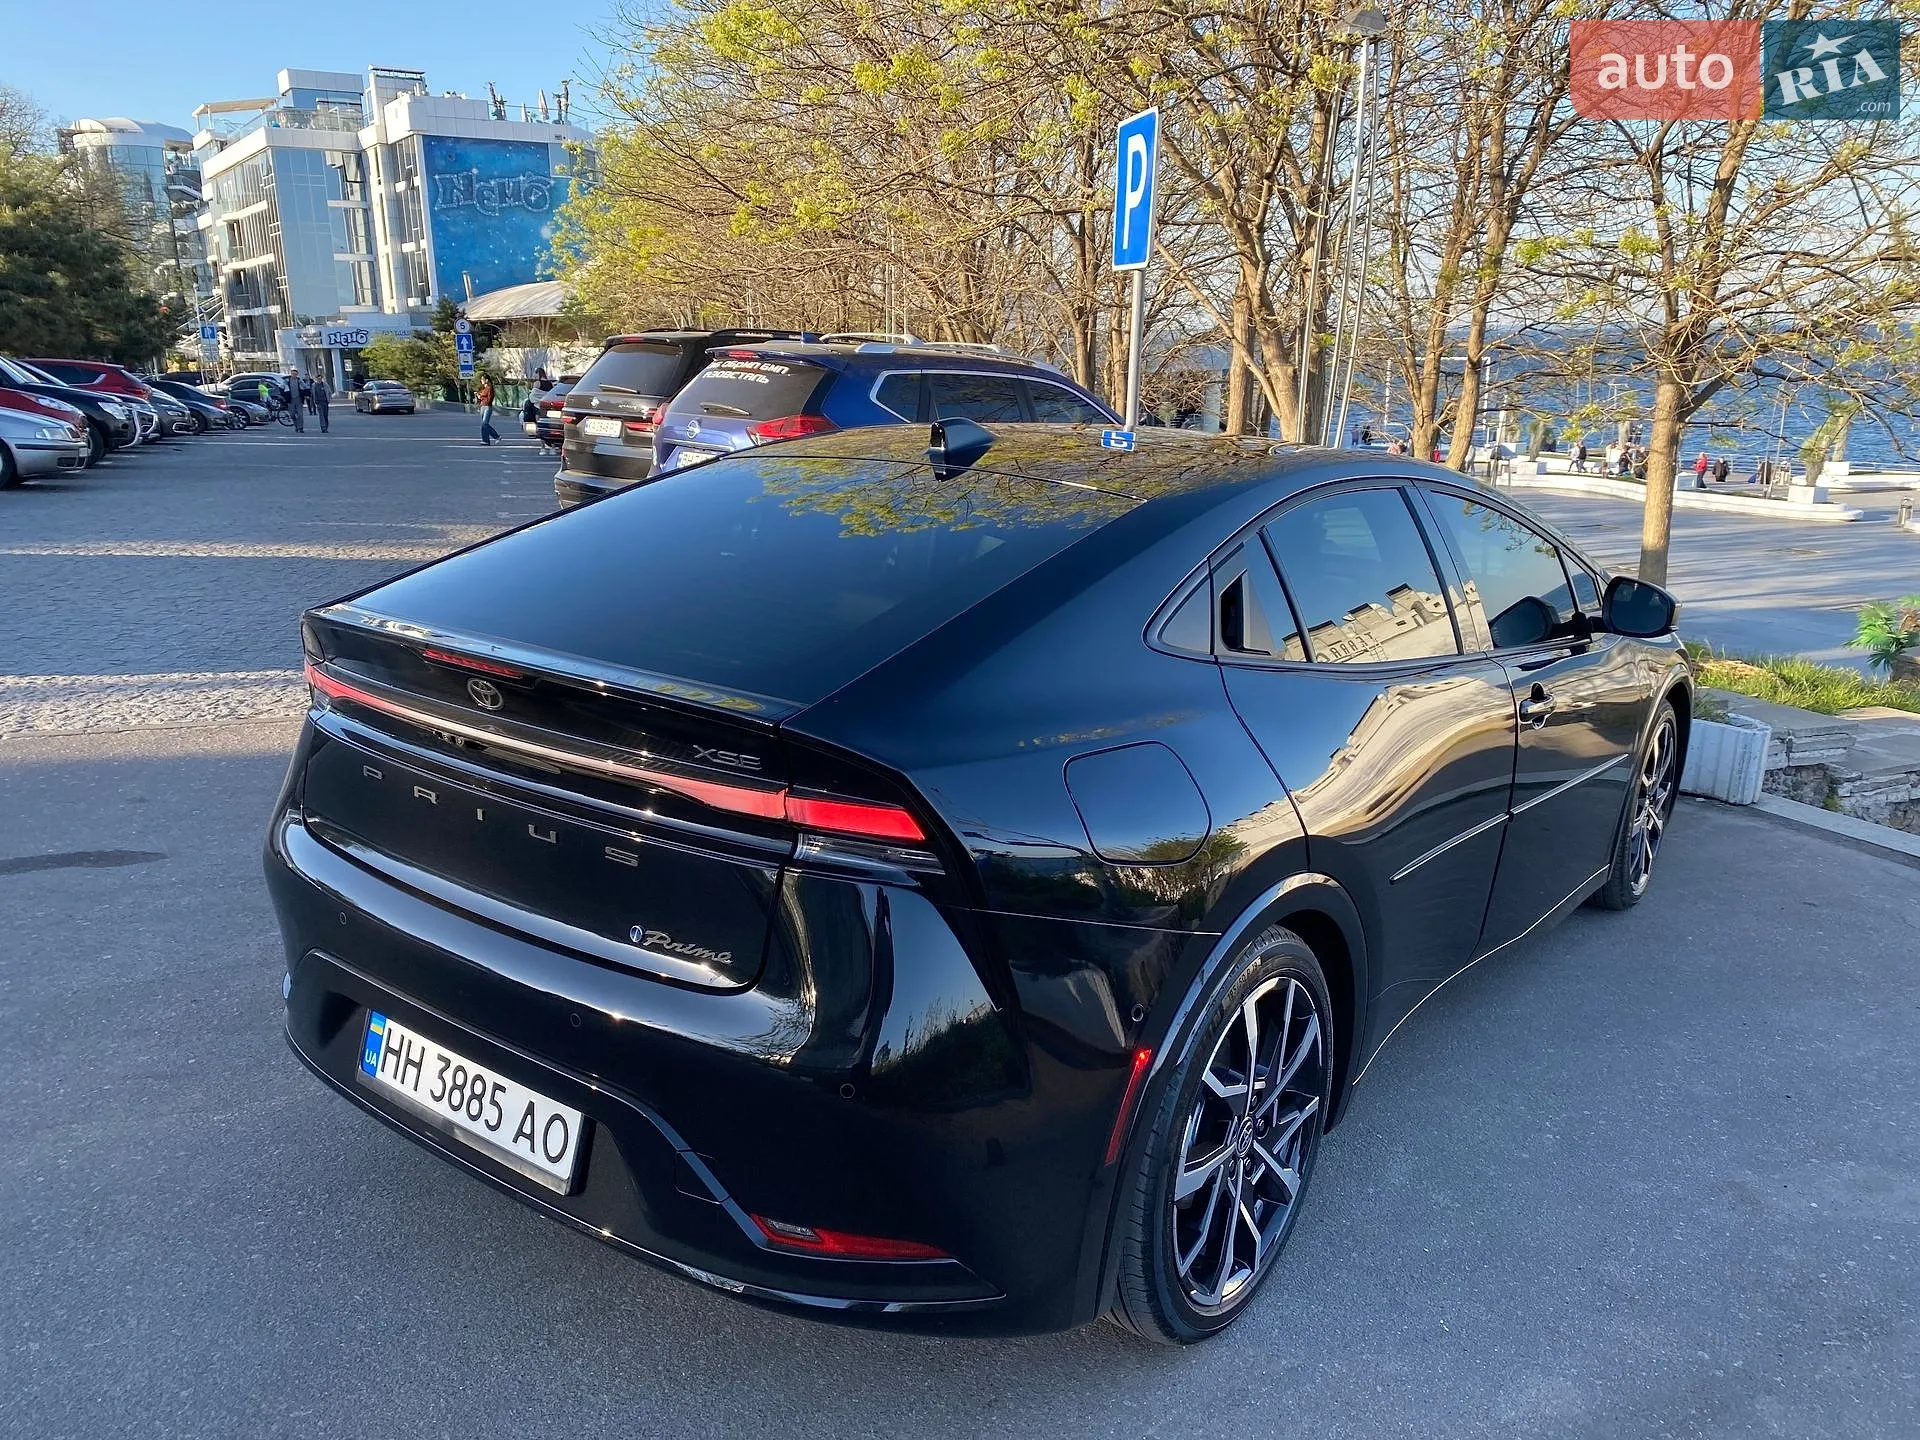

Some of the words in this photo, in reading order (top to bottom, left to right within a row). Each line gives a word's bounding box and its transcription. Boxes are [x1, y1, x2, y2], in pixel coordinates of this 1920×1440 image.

[1122, 133, 1148, 250] P
[692, 744, 762, 771] XSE
[362, 764, 639, 868] PRIUS
[642, 929, 734, 965] Prime
[364, 1053, 377, 1067] UA
[380, 1027, 426, 1092] HH
[430, 1052, 507, 1132] 3885
[512, 1100, 569, 1164] AO
